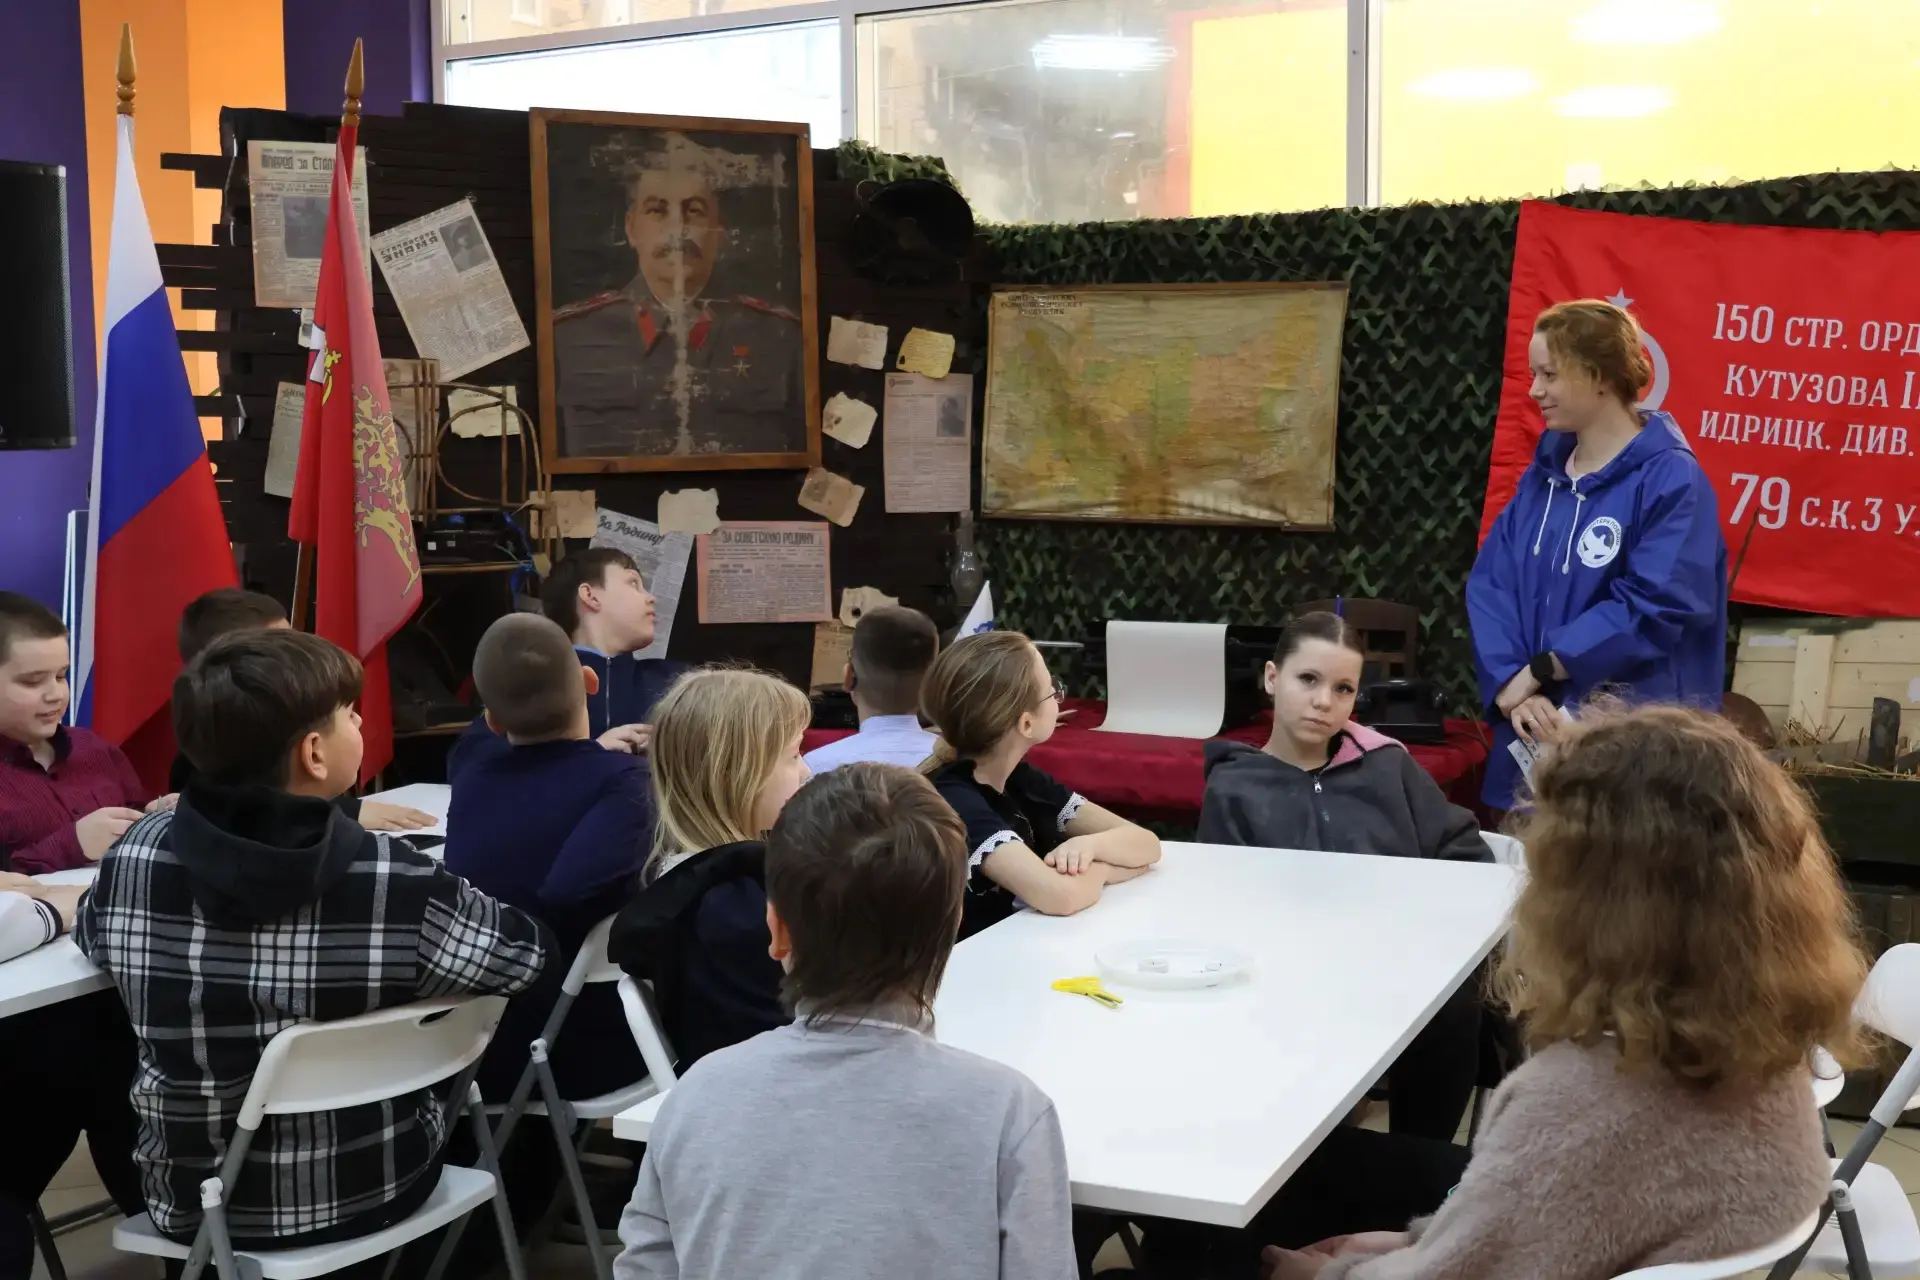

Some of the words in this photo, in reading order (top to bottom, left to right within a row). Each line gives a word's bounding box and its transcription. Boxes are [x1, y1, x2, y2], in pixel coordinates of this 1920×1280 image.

[1713, 303, 1775, 344] 150
[1784, 316, 1848, 350] СТР.
[1698, 410, 1831, 452] ИДРИЦК.
[1839, 424, 1914, 457] ДИВ.
[1729, 472, 1791, 530] 79
